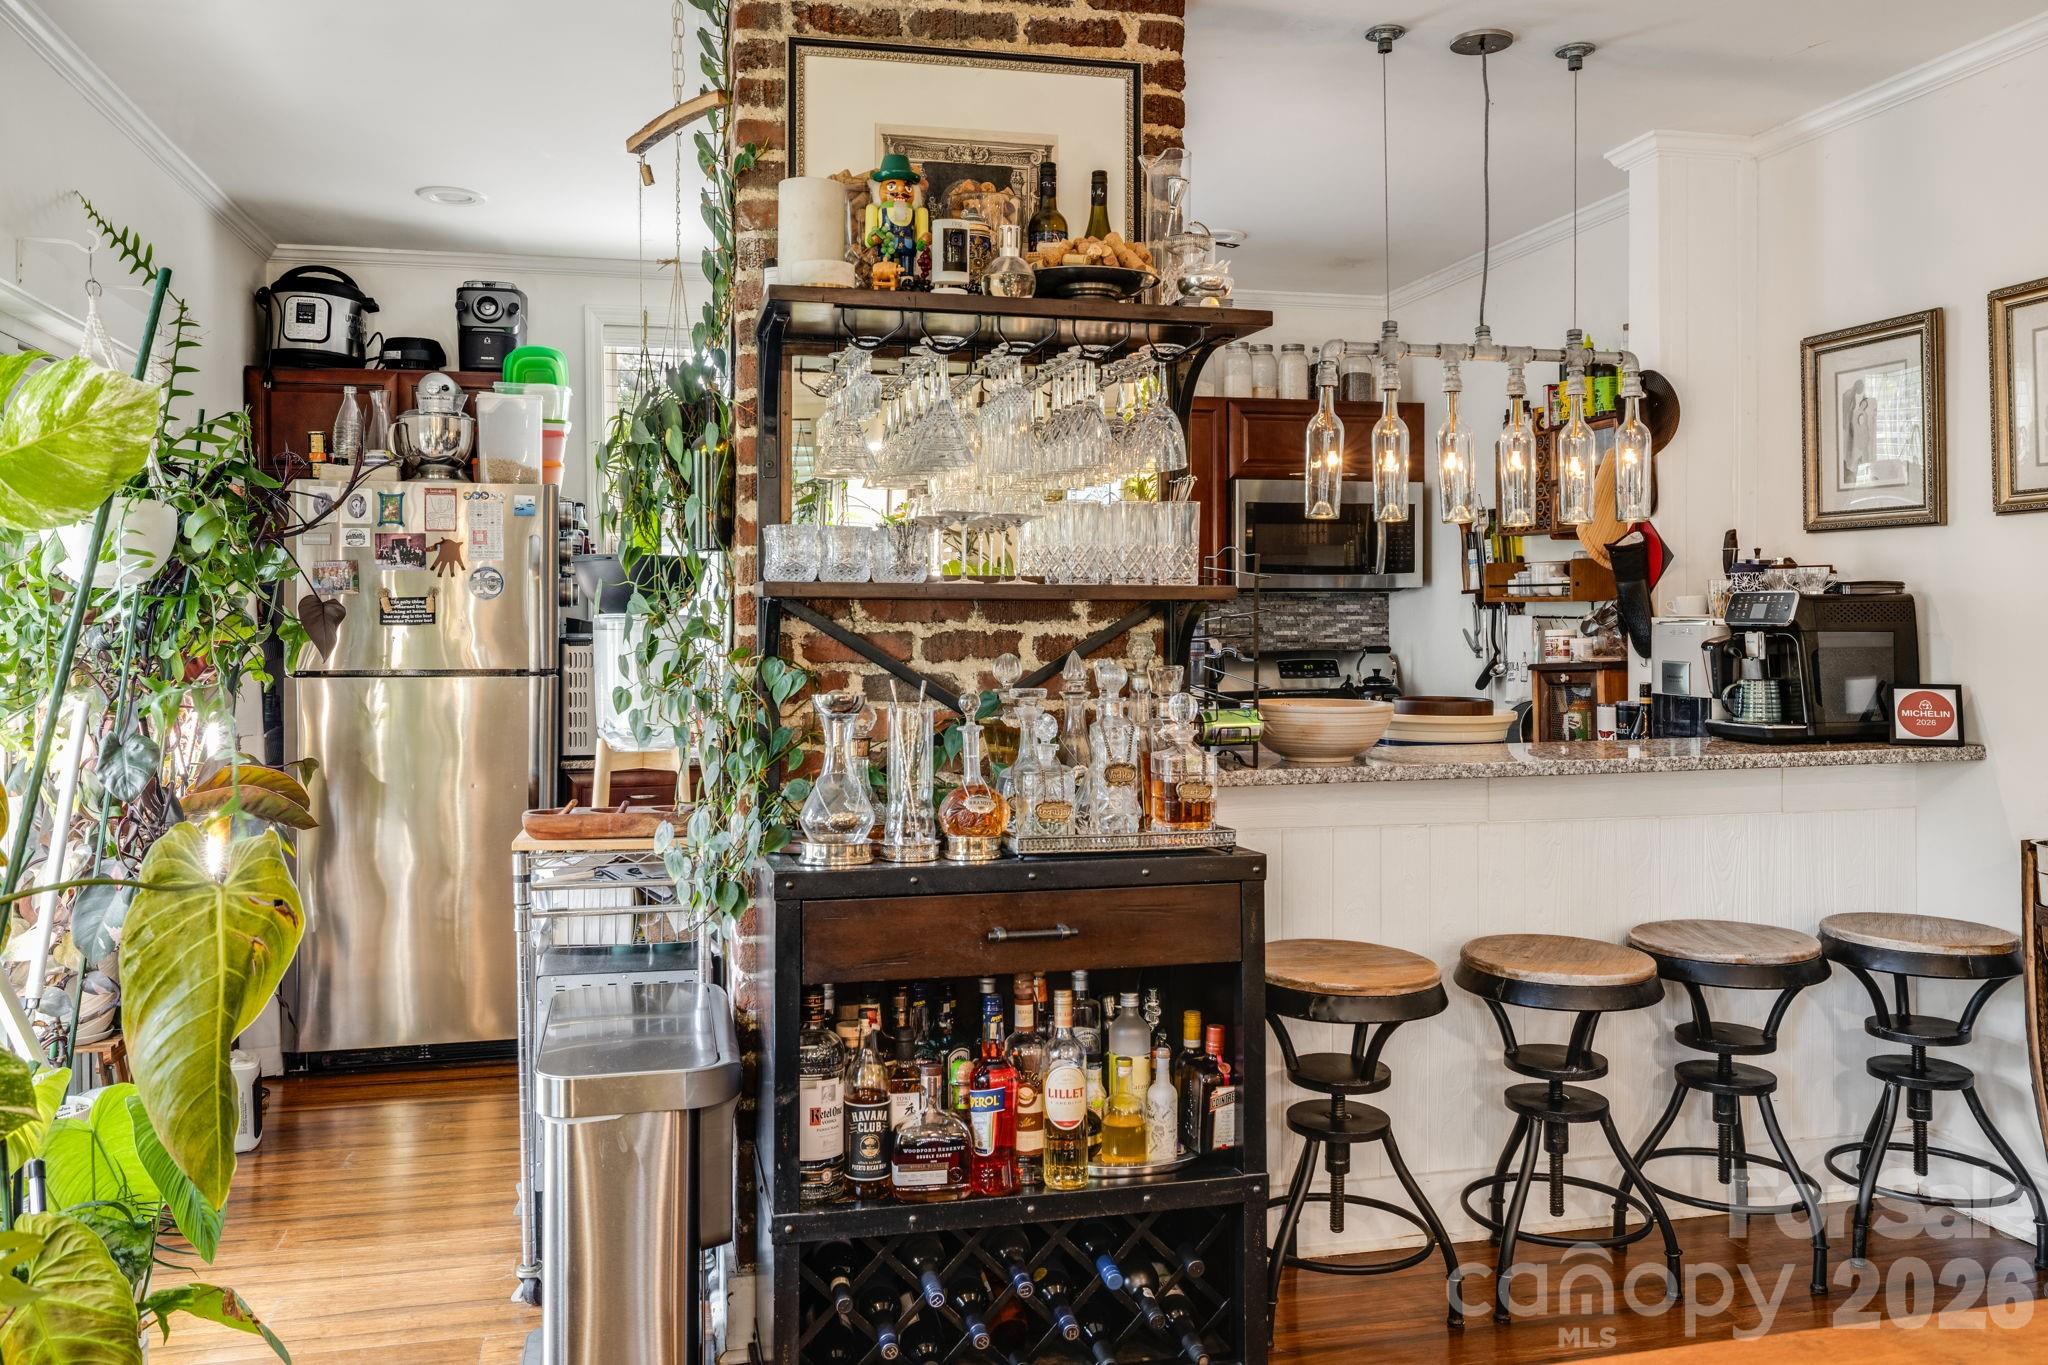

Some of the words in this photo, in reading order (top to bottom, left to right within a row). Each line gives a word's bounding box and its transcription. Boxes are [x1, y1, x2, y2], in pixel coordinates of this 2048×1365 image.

[1901, 709, 1951, 718] MICHELIN
[1048, 1087, 1085, 1099] LILLET
[969, 1095, 1000, 1109] PEROL
[810, 1107, 831, 1124] Ketel
[851, 1110, 888, 1122] HAVANA
[857, 1121, 883, 1133] CLUB
